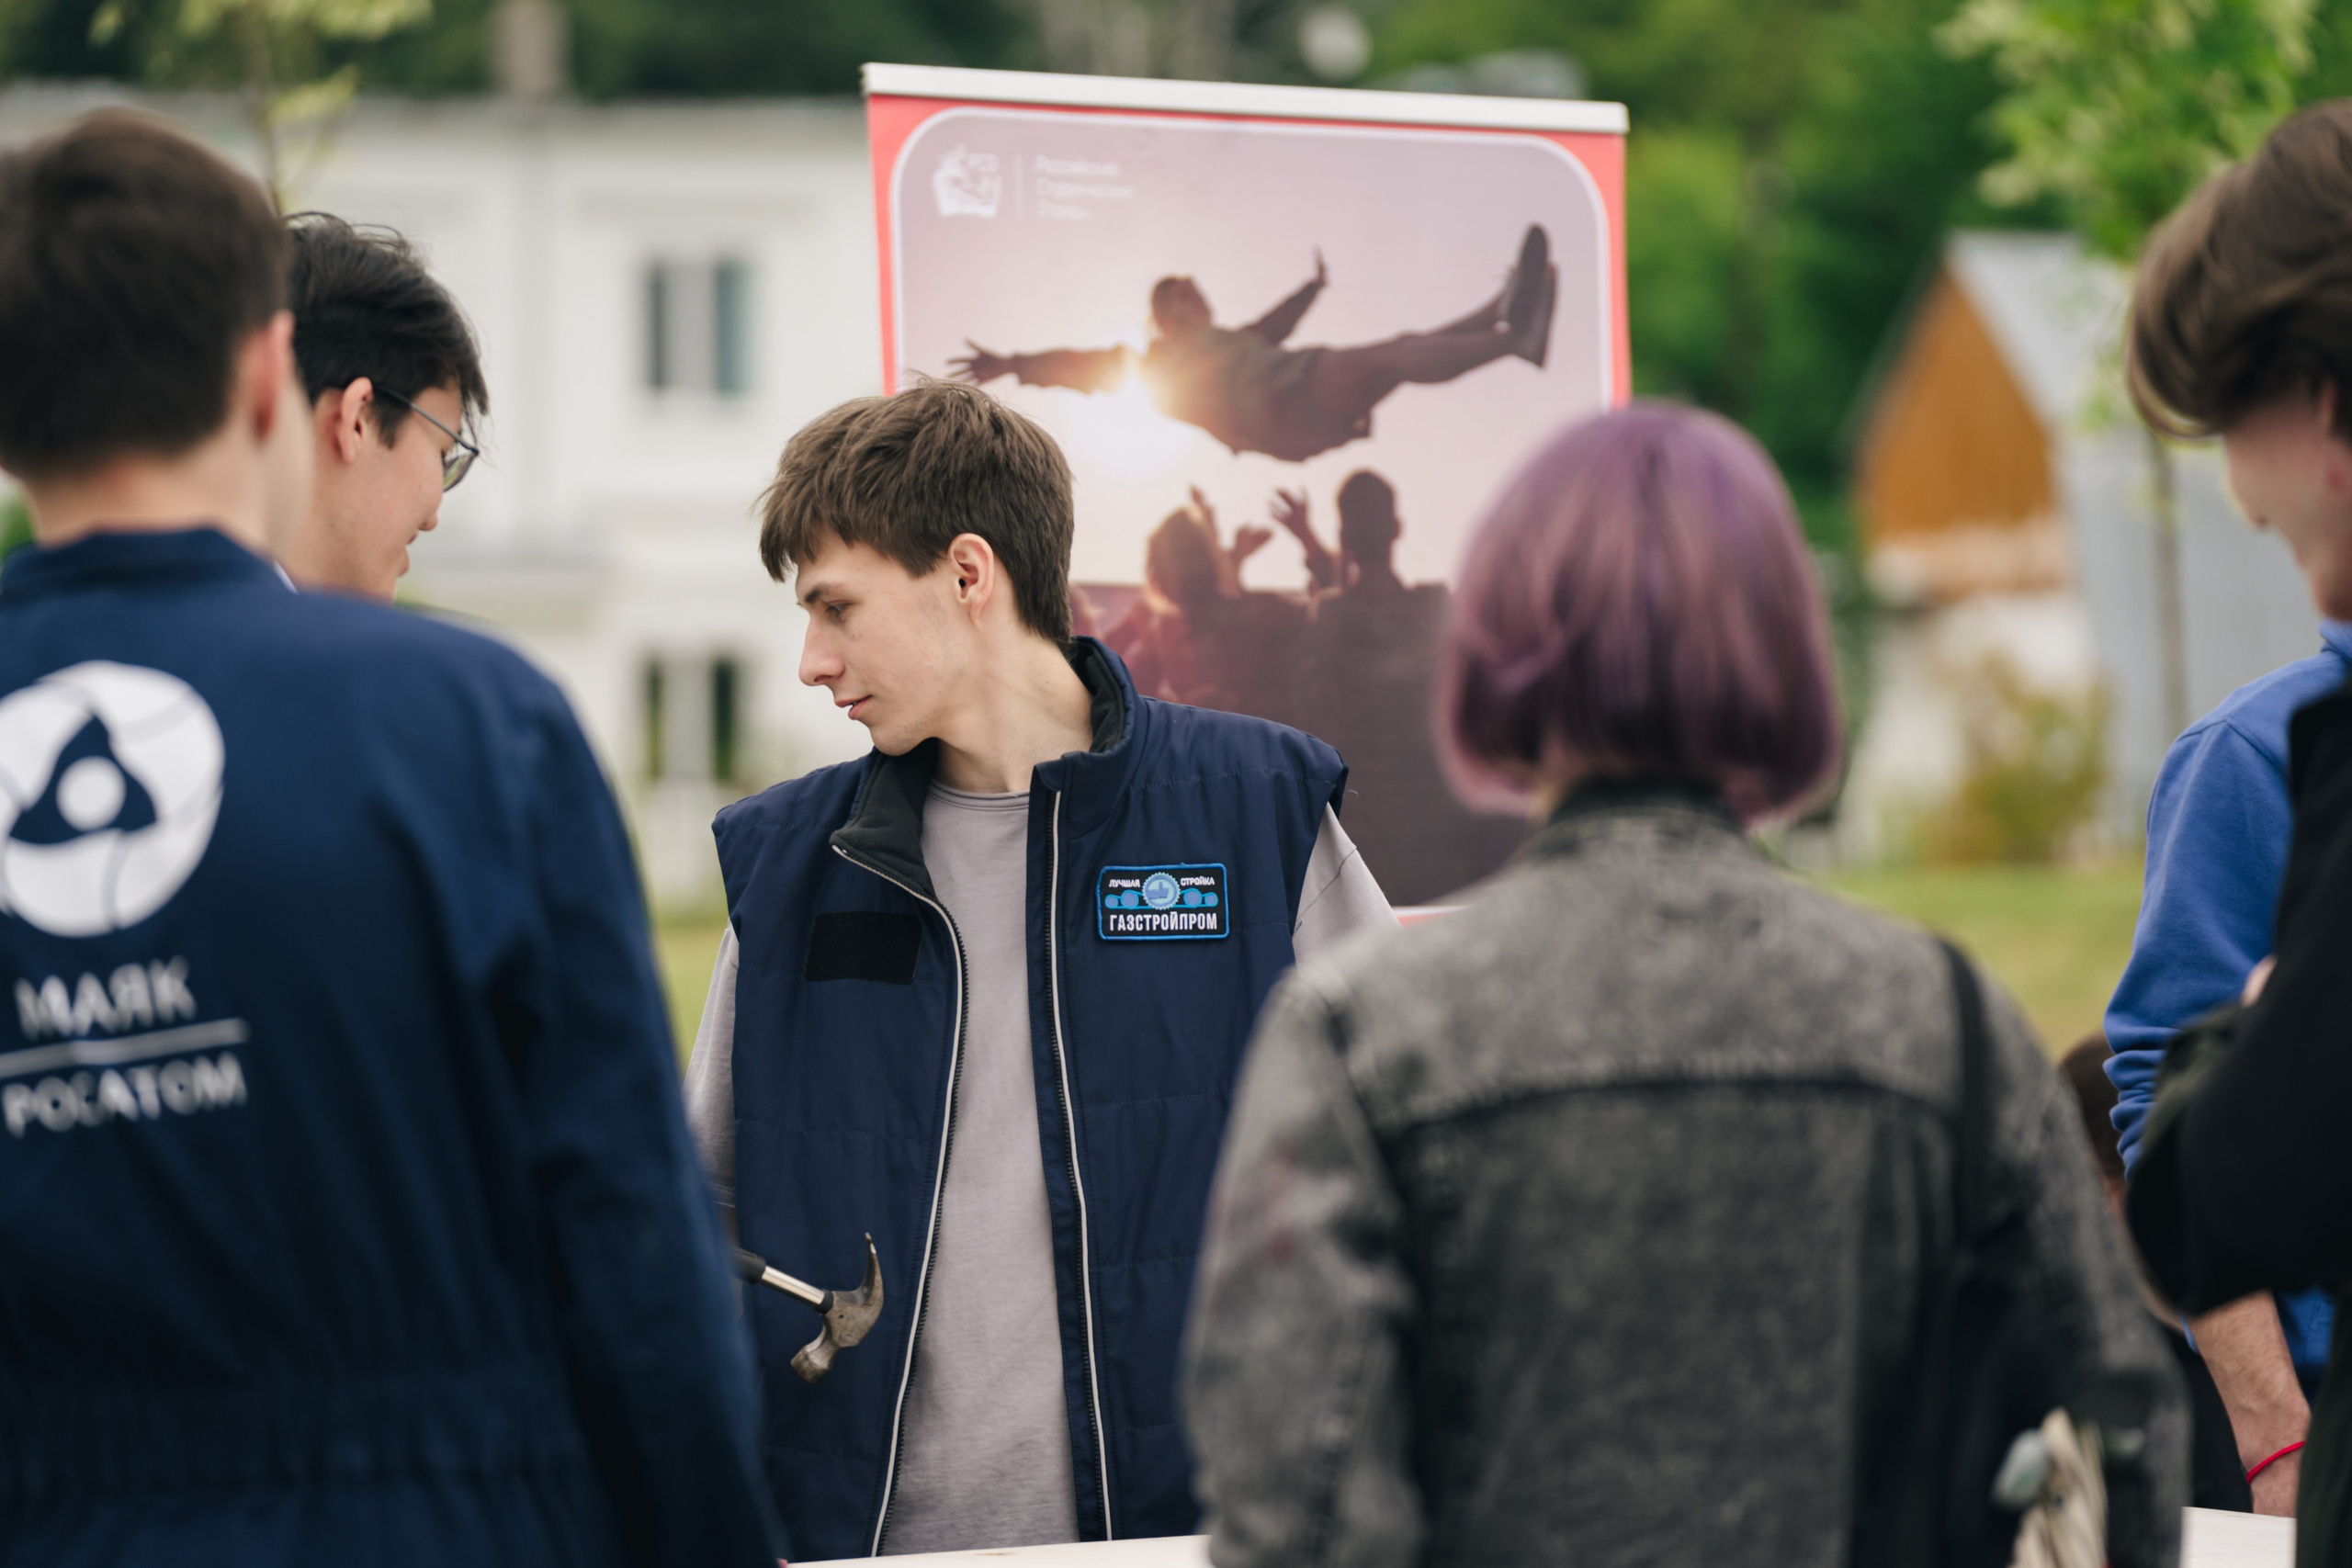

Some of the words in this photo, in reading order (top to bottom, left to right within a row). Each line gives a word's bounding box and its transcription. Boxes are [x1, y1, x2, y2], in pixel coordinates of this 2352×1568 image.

[1109, 878, 1140, 888] ЛУЧШАЯ
[1181, 875, 1216, 886] СТРОЙКА
[1109, 911, 1217, 931] ГАЗСТРОЙПРОМ
[15, 955, 196, 1041] МАЯК
[4, 1052, 247, 1138] РОСАТОМ
